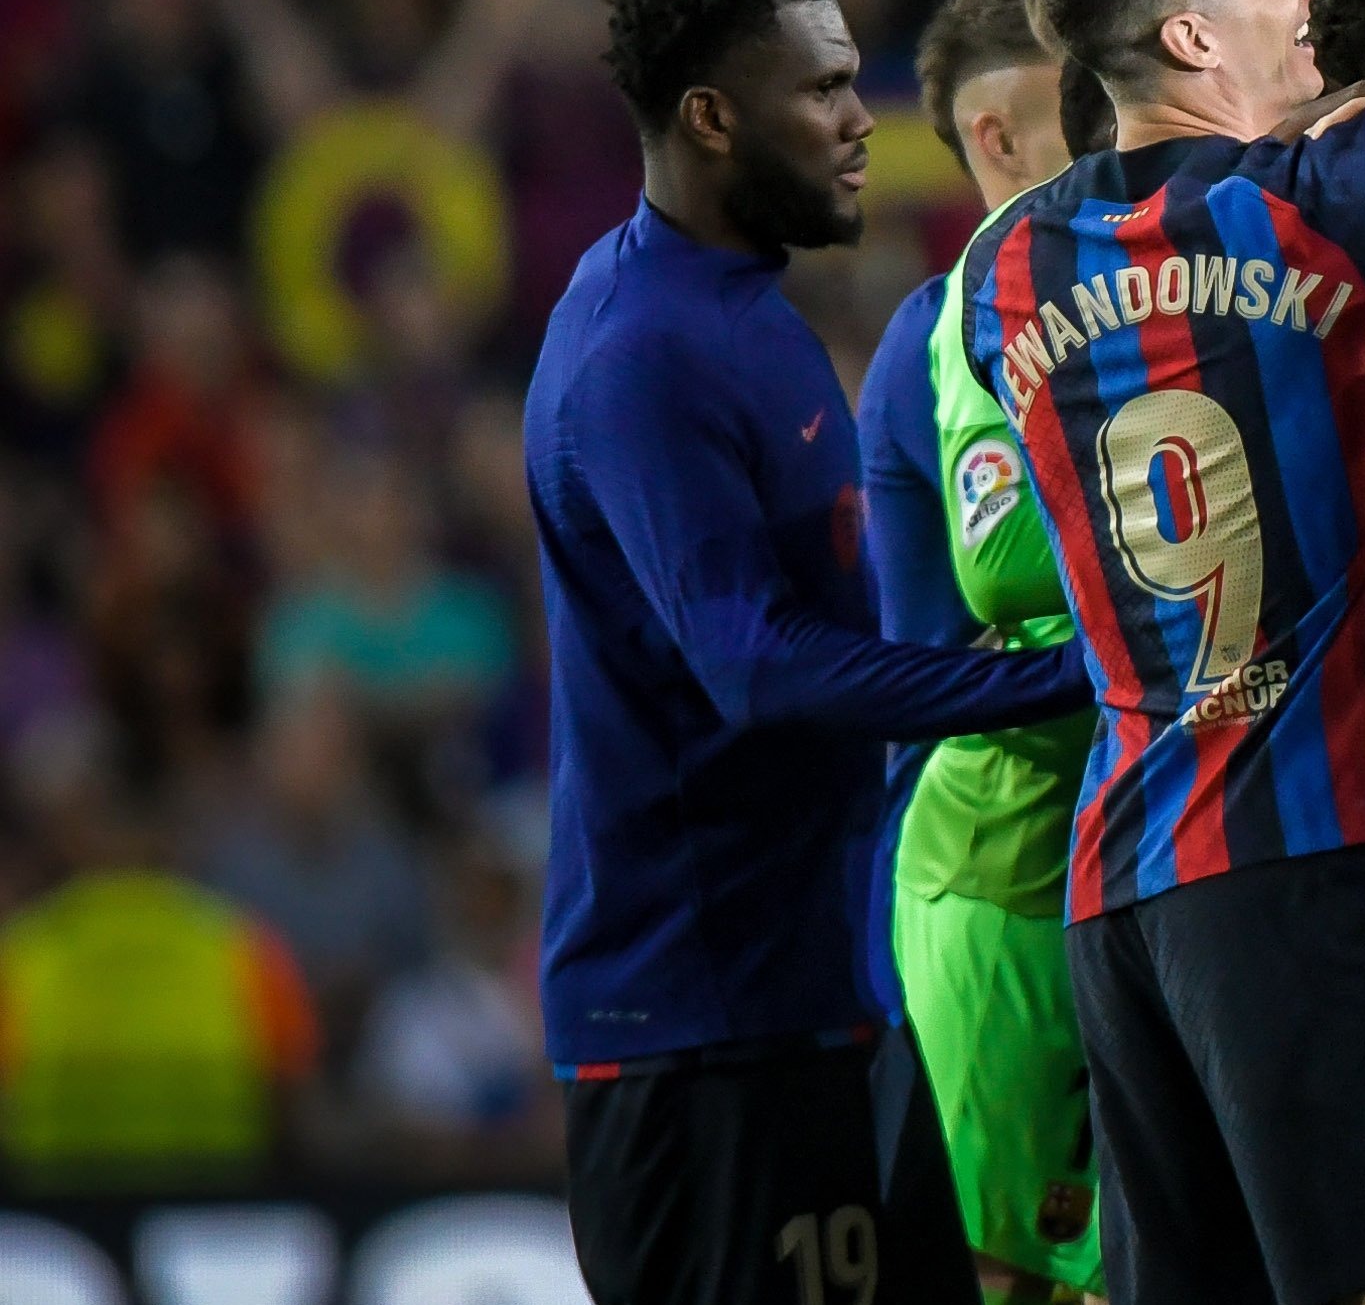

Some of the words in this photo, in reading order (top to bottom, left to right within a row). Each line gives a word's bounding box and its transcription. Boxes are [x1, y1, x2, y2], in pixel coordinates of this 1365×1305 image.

[1001, 254, 1353, 432] LEWANDOWSKI
[1098, 389, 1263, 692] 9
[776, 1204, 878, 1305] 19
